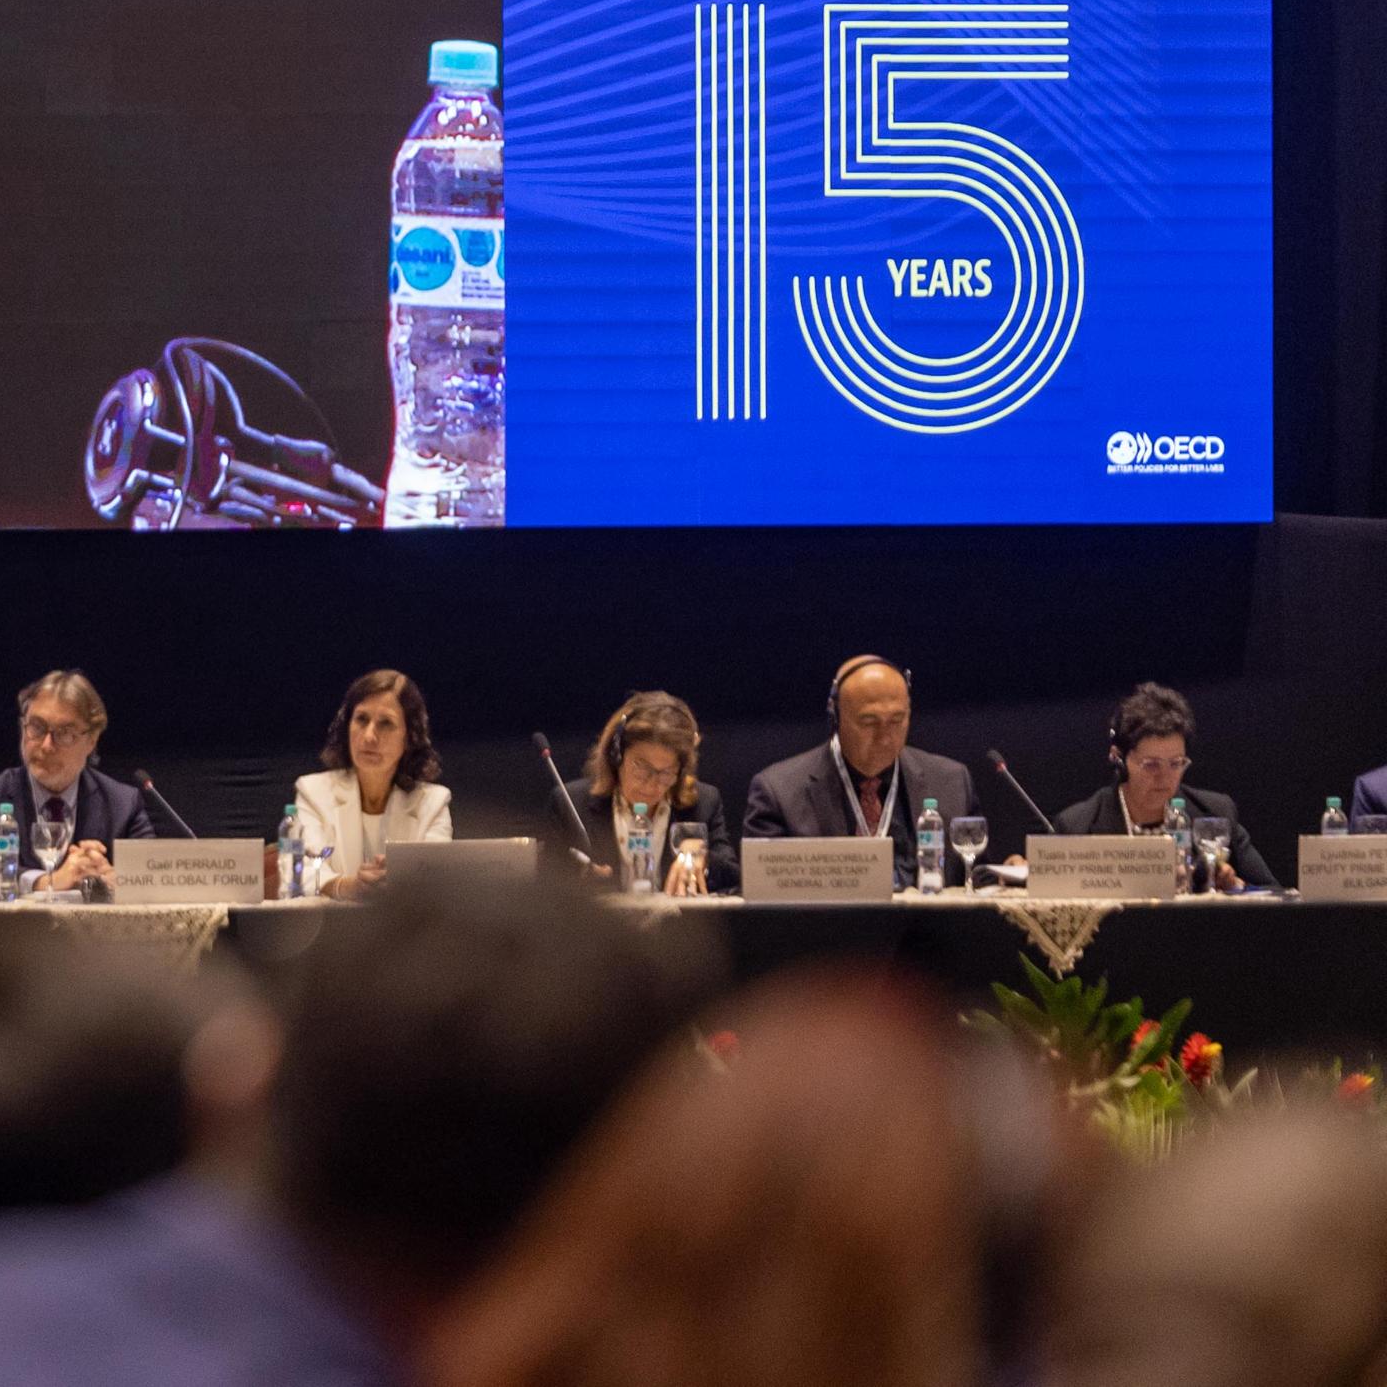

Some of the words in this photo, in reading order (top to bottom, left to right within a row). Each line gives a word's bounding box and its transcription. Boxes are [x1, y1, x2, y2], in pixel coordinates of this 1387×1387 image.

[696, 4, 1084, 434] 15
[887, 259, 992, 297] YEARS
[1154, 436, 1225, 460] OECD
[177, 859, 236, 870] PERRAUD
[1029, 865, 1076, 874] DEPUTY
[1079, 865, 1114, 874] PRIME
[1118, 865, 1172, 874] MINISTER
[162, 875, 208, 886] GLOBAL
[213, 875, 258, 886] FORUM
[1081, 879, 1122, 889] SAMOA
